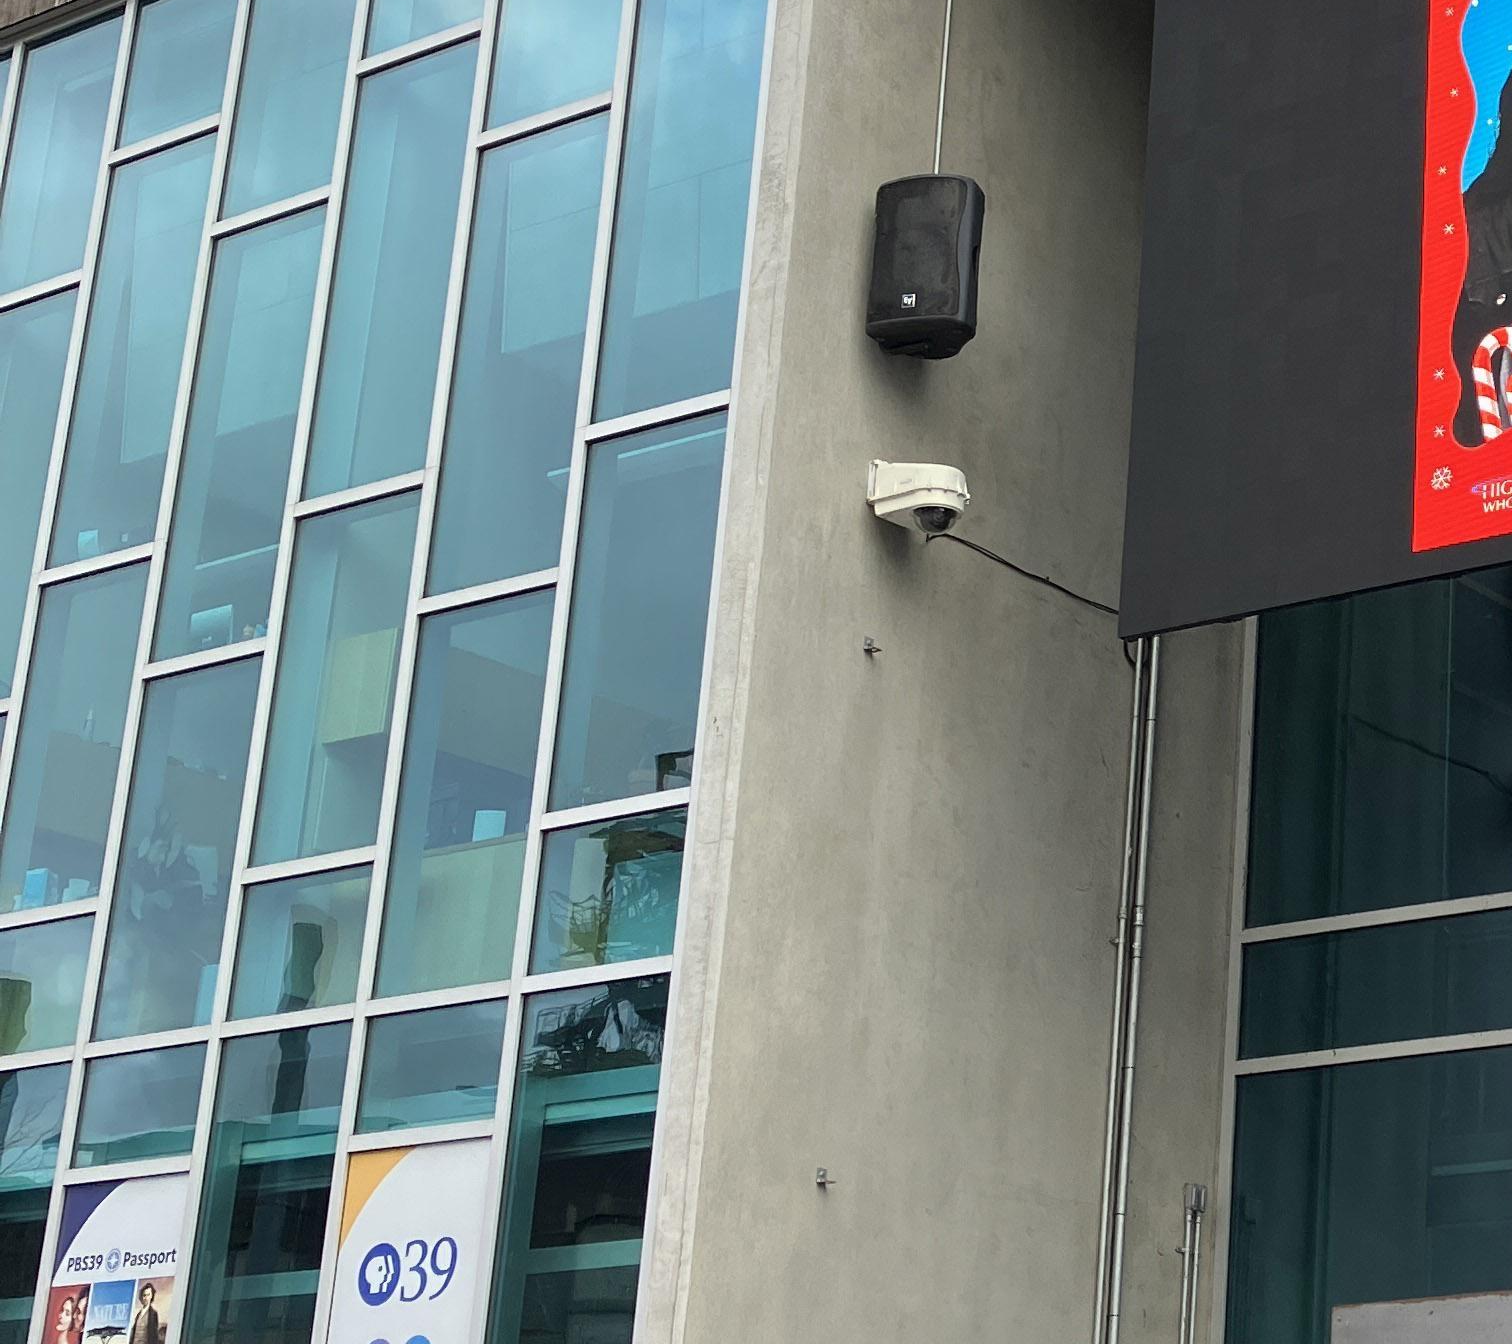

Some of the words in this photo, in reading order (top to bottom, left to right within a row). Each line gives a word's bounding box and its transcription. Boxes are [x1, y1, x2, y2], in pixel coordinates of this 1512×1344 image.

[66, 1254, 103, 1273] PBS39
[123, 1248, 177, 1269] Passport
[400, 1236, 458, 1303] 39
